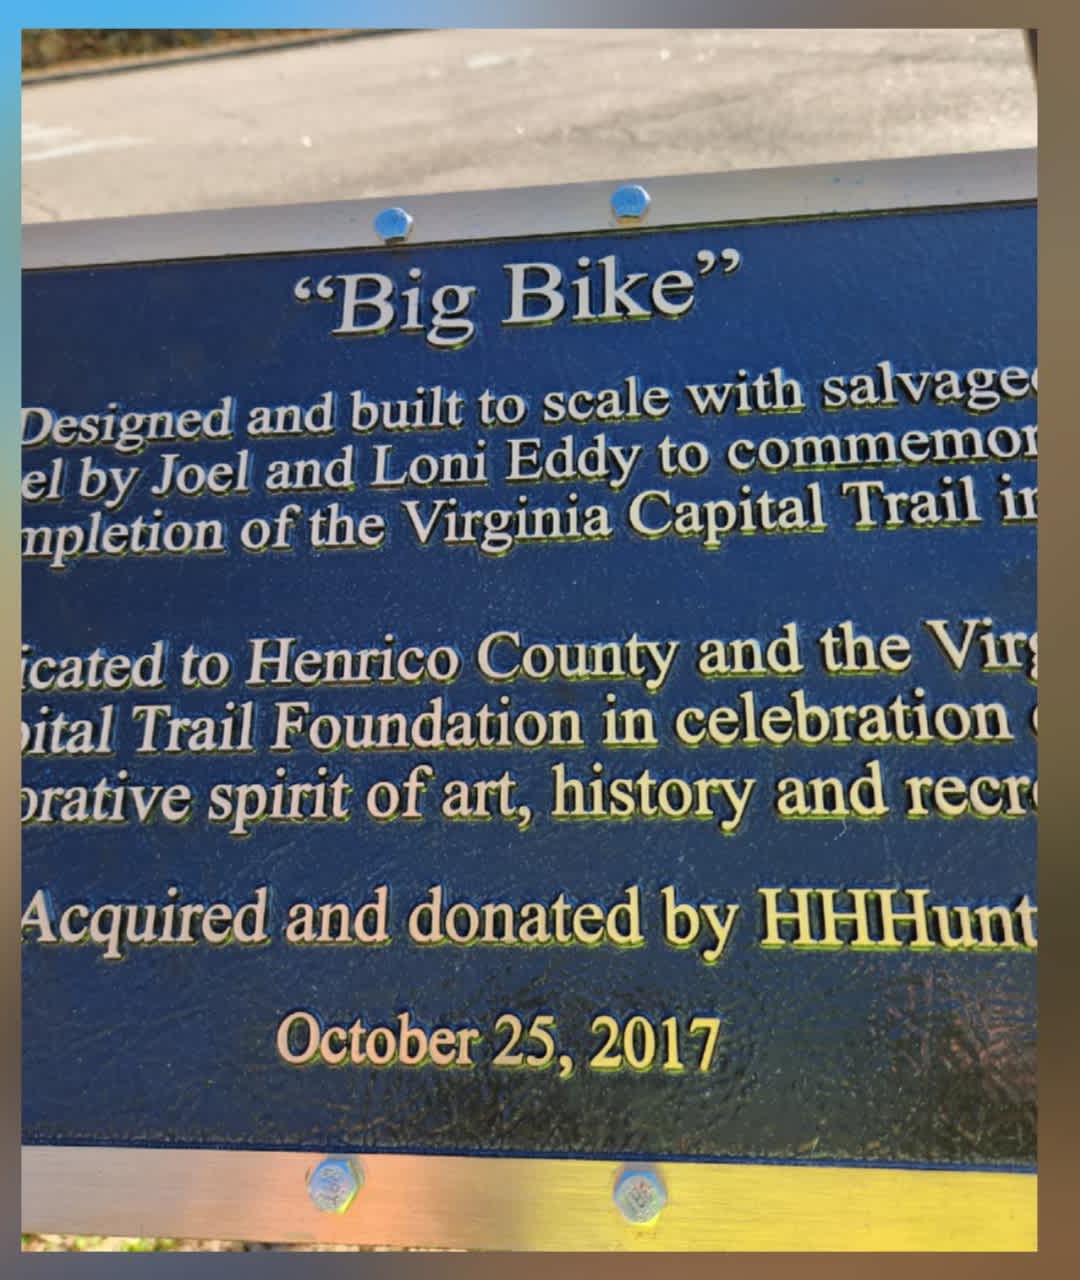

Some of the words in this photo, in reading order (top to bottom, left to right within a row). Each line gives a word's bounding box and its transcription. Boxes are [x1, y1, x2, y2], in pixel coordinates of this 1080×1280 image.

[295, 268, 478, 349] “Big
[502, 248, 740, 325] Bike”
[22, 396, 232, 453] Designed
[248, 392, 332, 434] and
[351, 386, 462, 432] built
[479, 389, 525, 424] to
[544, 376, 669, 421] scale
[686, 368, 805, 413] with
[22, 458, 62, 499] el
[79, 456, 139, 508] by
[152, 449, 248, 496] Joel
[266, 445, 354, 491] and
[371, 440, 487, 485] Loni
[506, 433, 641, 488] Eddy
[659, 436, 708, 472] to
[728, 425, 1037, 472] commemor
[241, 504, 301, 551] of
[309, 503, 384, 546] the
[402, 493, 612, 555] Virginia
[630, 483, 827, 549] Capital
[843, 476, 981, 529] Trail
[182, 645, 229, 687] to
[246, 634, 458, 686] Henrico
[478, 631, 679, 690] County
[700, 623, 804, 677] and
[820, 622, 912, 675] the
[132, 701, 252, 751] Trail
[270, 696, 584, 749] Foundation
[603, 694, 658, 748] in
[677, 688, 1014, 748] celebration
[208, 767, 351, 834] spirit
[367, 766, 432, 821] of
[443, 772, 530, 831] art,
[552, 763, 756, 834] history
[778, 760, 889, 819] and
[22, 887, 270, 959] Acquired
[287, 886, 391, 945] and
[409, 885, 644, 948] donated
[661, 886, 739, 962] by
[758, 888, 1037, 952] HHHunt
[277, 1012, 479, 1069] October
[493, 1015, 573, 1078] 25,
[590, 1016, 720, 1073] 2017
